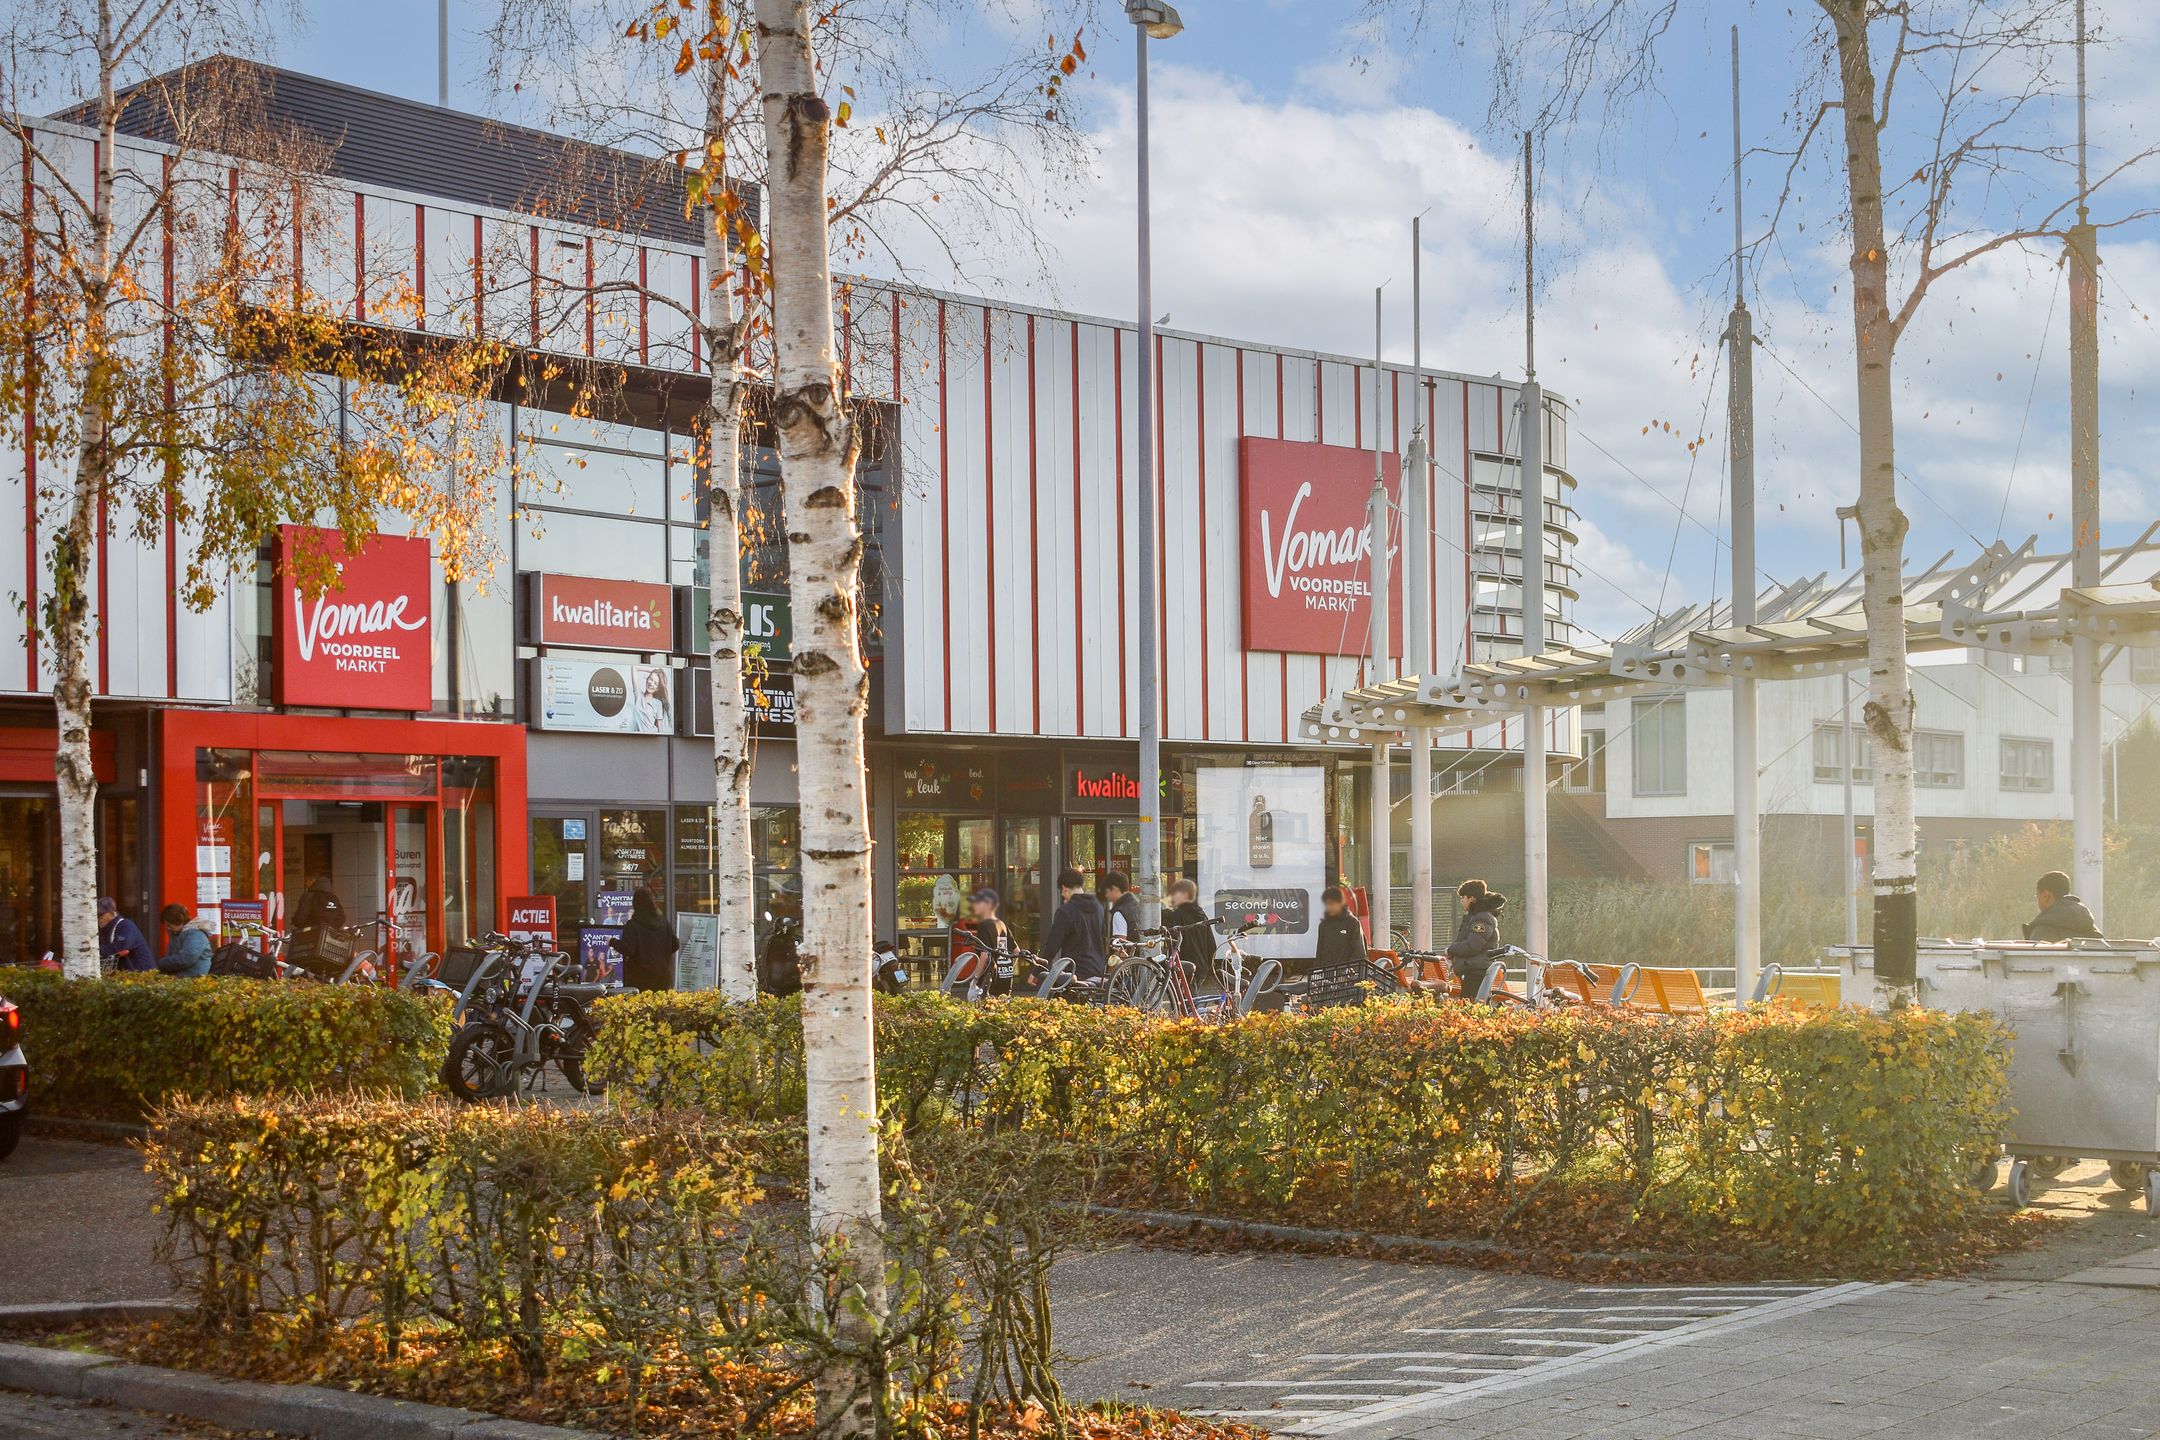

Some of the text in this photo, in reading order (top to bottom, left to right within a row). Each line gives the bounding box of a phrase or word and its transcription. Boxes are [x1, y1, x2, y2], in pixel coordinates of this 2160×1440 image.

[1290, 576, 1371, 596] VOORDEEL
[1306, 595, 1357, 612] MARKT
[553, 595, 651, 630] kwalitaria
[321, 642, 400, 660] VOORDEEL
[336, 658, 386, 673] MARKT
[592, 686, 610, 694] LASER
[917, 778, 942, 794] leuk
[1078, 770, 1140, 798] kwalitar
[1225, 899, 1298, 910] second love
[512, 909, 550, 924] ACTIE!
